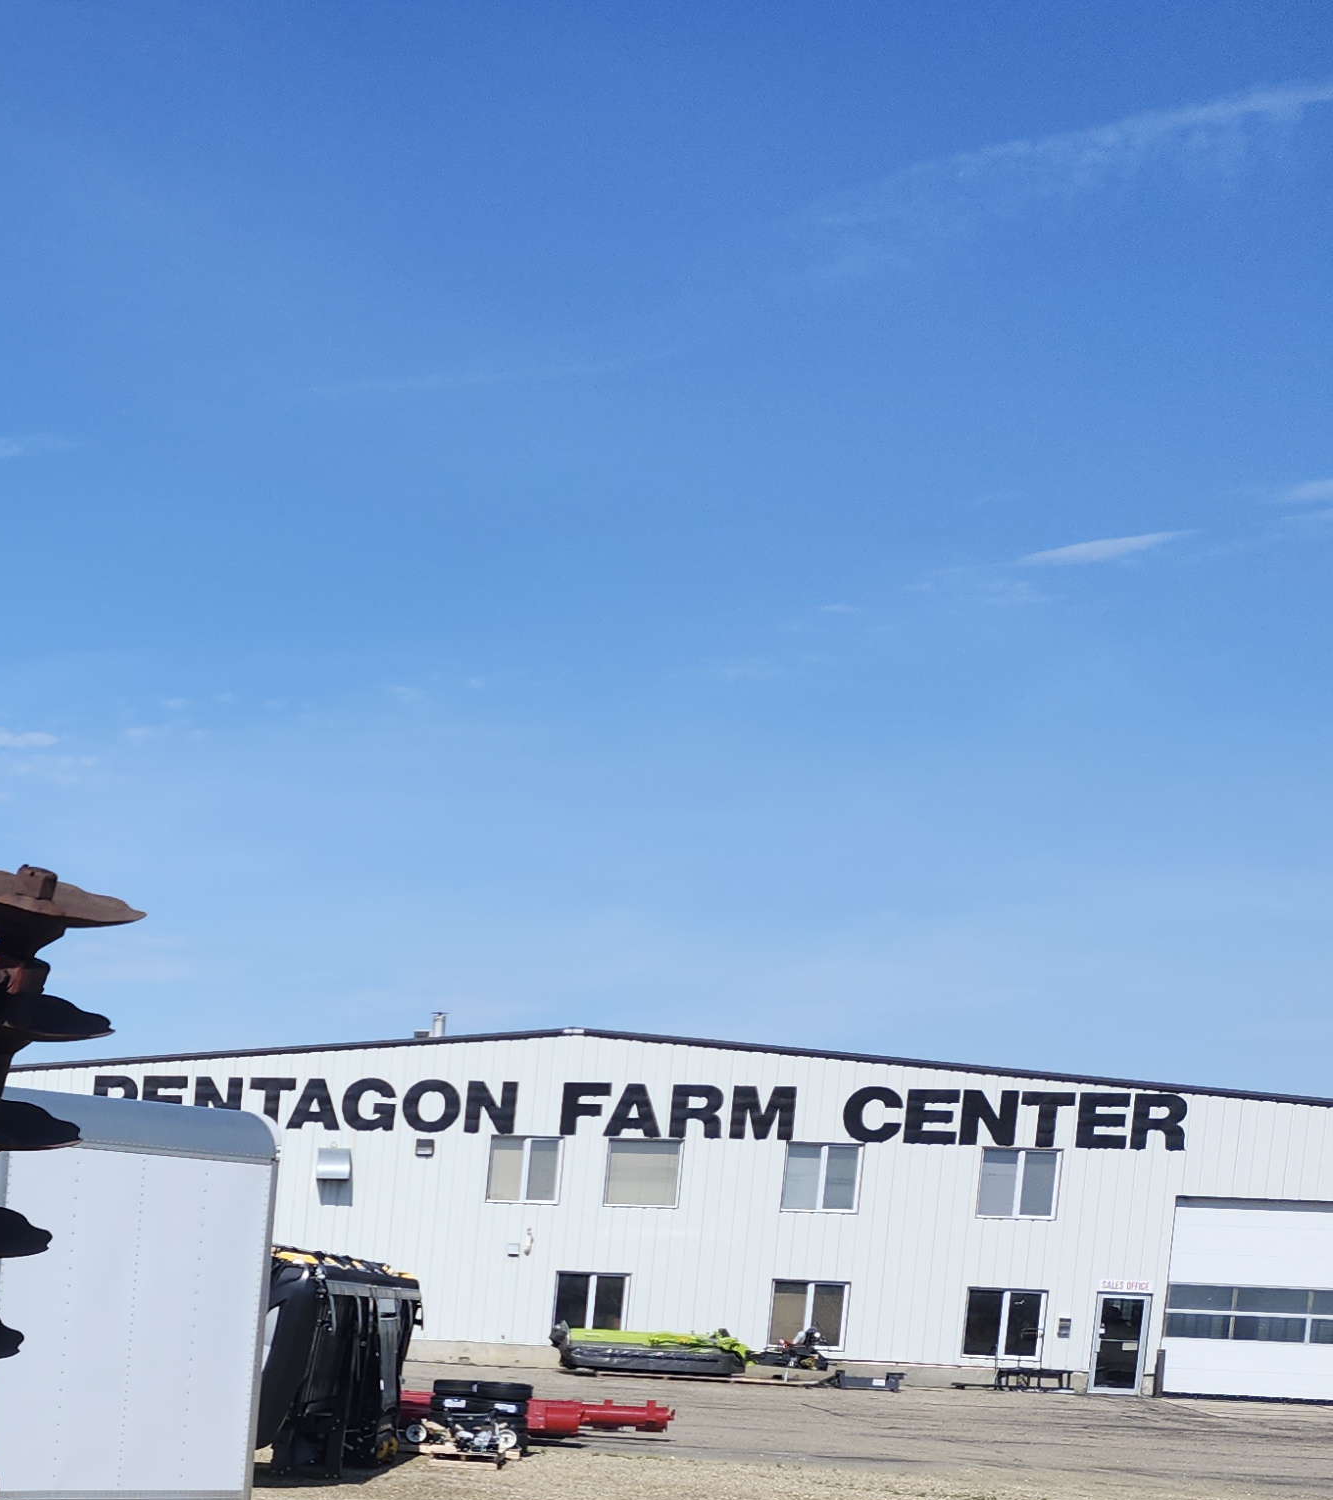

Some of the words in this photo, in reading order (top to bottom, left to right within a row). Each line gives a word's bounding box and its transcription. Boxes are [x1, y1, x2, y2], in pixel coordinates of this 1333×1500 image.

[559, 1082, 797, 1140] FARM
[842, 1085, 1188, 1151] CENTER
[1102, 1280, 1124, 1290] SALES
[1127, 1281, 1150, 1291] OFFICE
